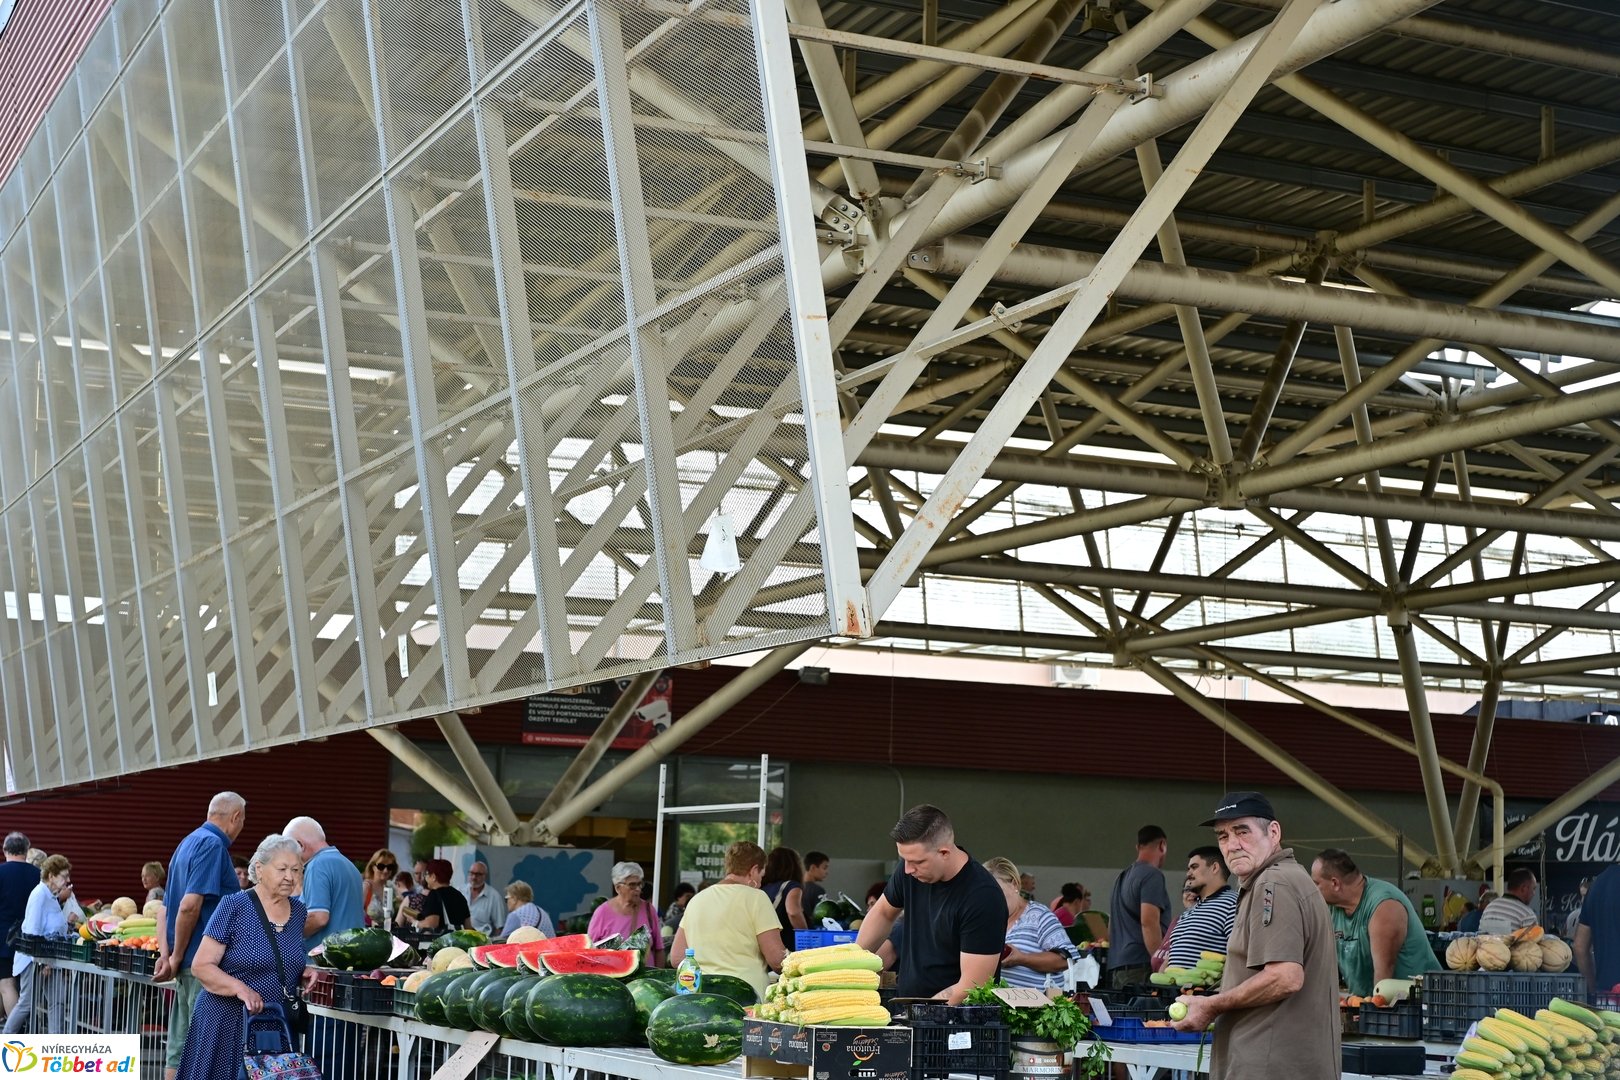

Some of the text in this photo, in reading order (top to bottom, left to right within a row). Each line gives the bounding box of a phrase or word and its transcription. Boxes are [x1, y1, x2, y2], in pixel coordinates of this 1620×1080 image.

[698, 844, 709, 853] AZ
[696, 857, 725, 866] DEFIBR
[704, 868, 724, 879] TALÁ
[846, 1045, 881, 1055] Fruitona
